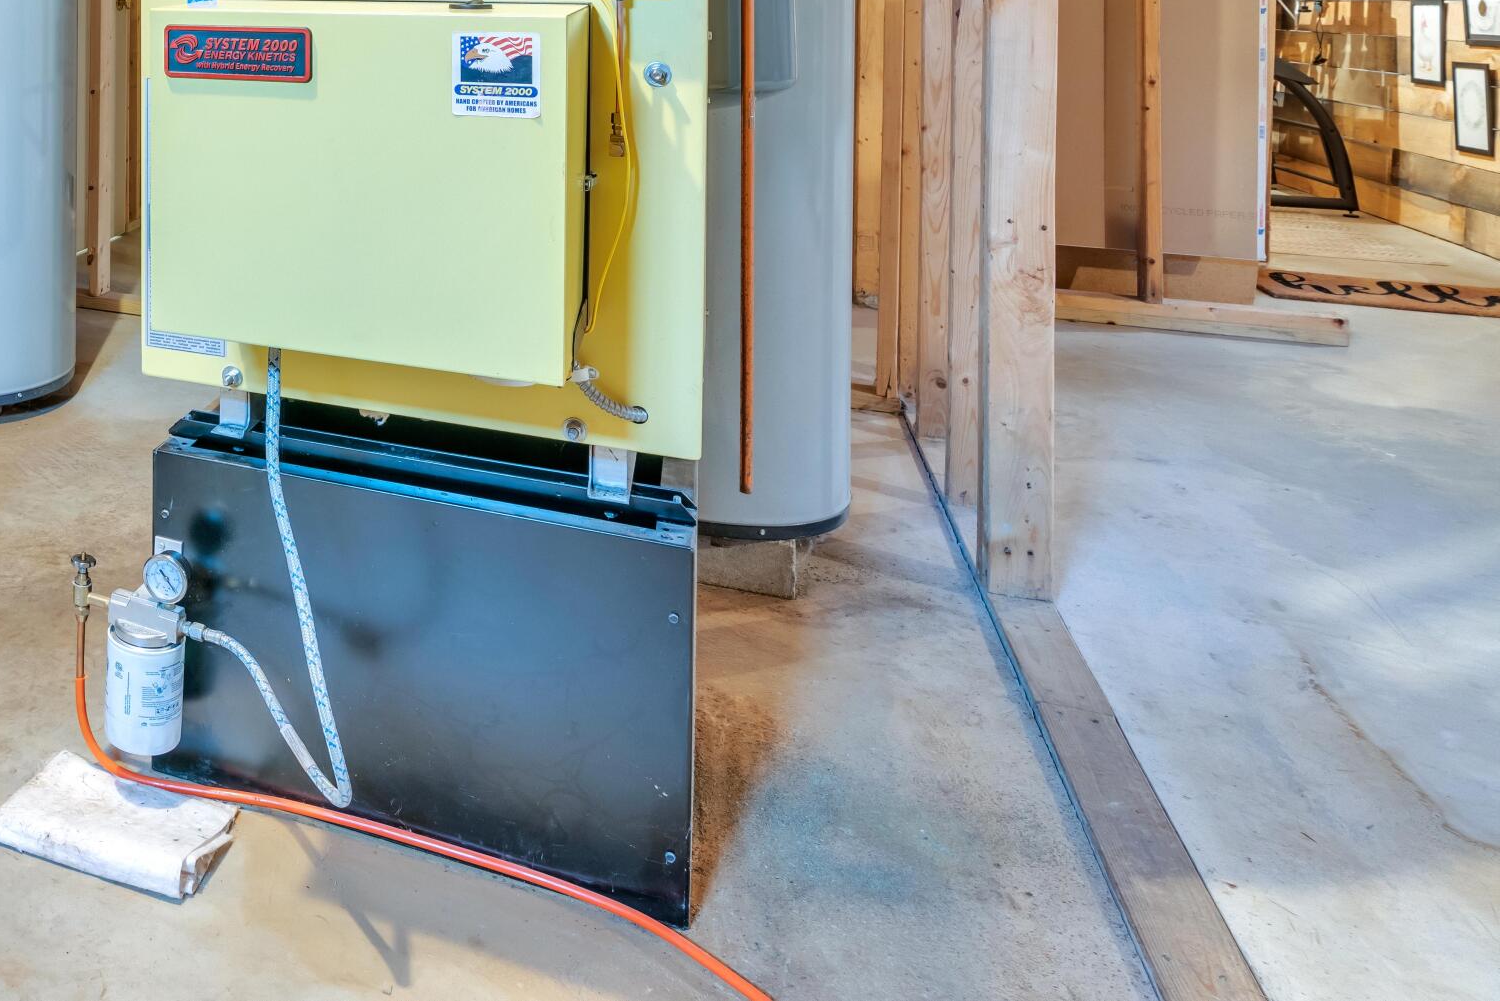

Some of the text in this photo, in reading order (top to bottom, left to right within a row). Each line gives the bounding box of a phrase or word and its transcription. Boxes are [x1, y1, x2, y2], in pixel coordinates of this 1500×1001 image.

[204, 37, 298, 52] SYSTEM 2000
[204, 50, 297, 62] ENERGY KINETICS
[196, 61, 294, 73] with Hybrid Energy Recovery
[459, 85, 533, 96] SYSTEM 2000
